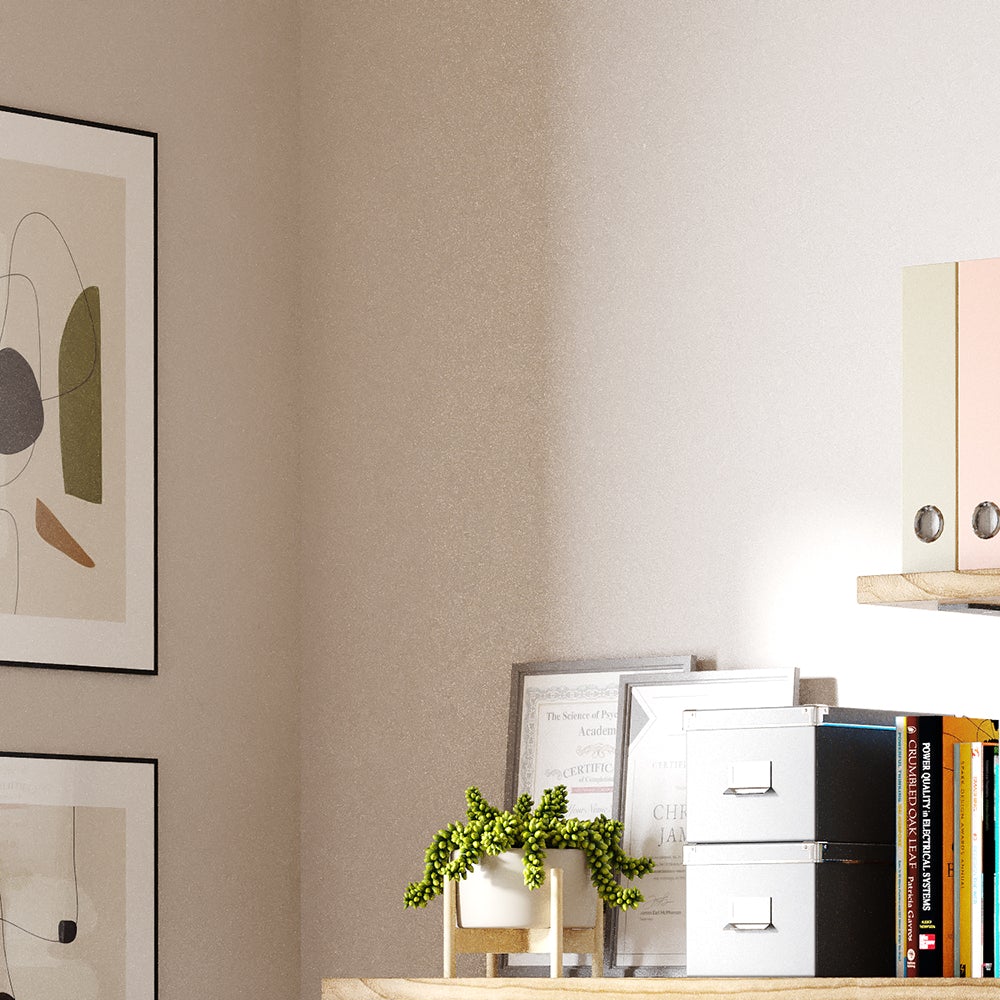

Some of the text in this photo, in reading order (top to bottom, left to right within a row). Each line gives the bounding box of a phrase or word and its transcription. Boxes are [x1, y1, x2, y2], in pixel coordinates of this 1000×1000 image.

[547, 708, 618, 723] The Science of Psyc
[578, 724, 616, 737] Academ
[563, 762, 613, 779] CERTIFIC
[922, 742, 932, 771] POWER
[908, 739, 918, 806] CRUMBLED
[920, 772, 932, 810] QUALITY
[653, 803, 687, 821] CHR
[908, 808, 918, 836] OAK
[922, 810, 932, 818] in
[908, 838, 918, 870] LEAF
[922, 818, 932, 871] ELECTRICAL
[907, 876, 915, 908] Patricia
[922, 872, 932, 912] SYSTEMS
[907, 909, 915, 942] Gavros
